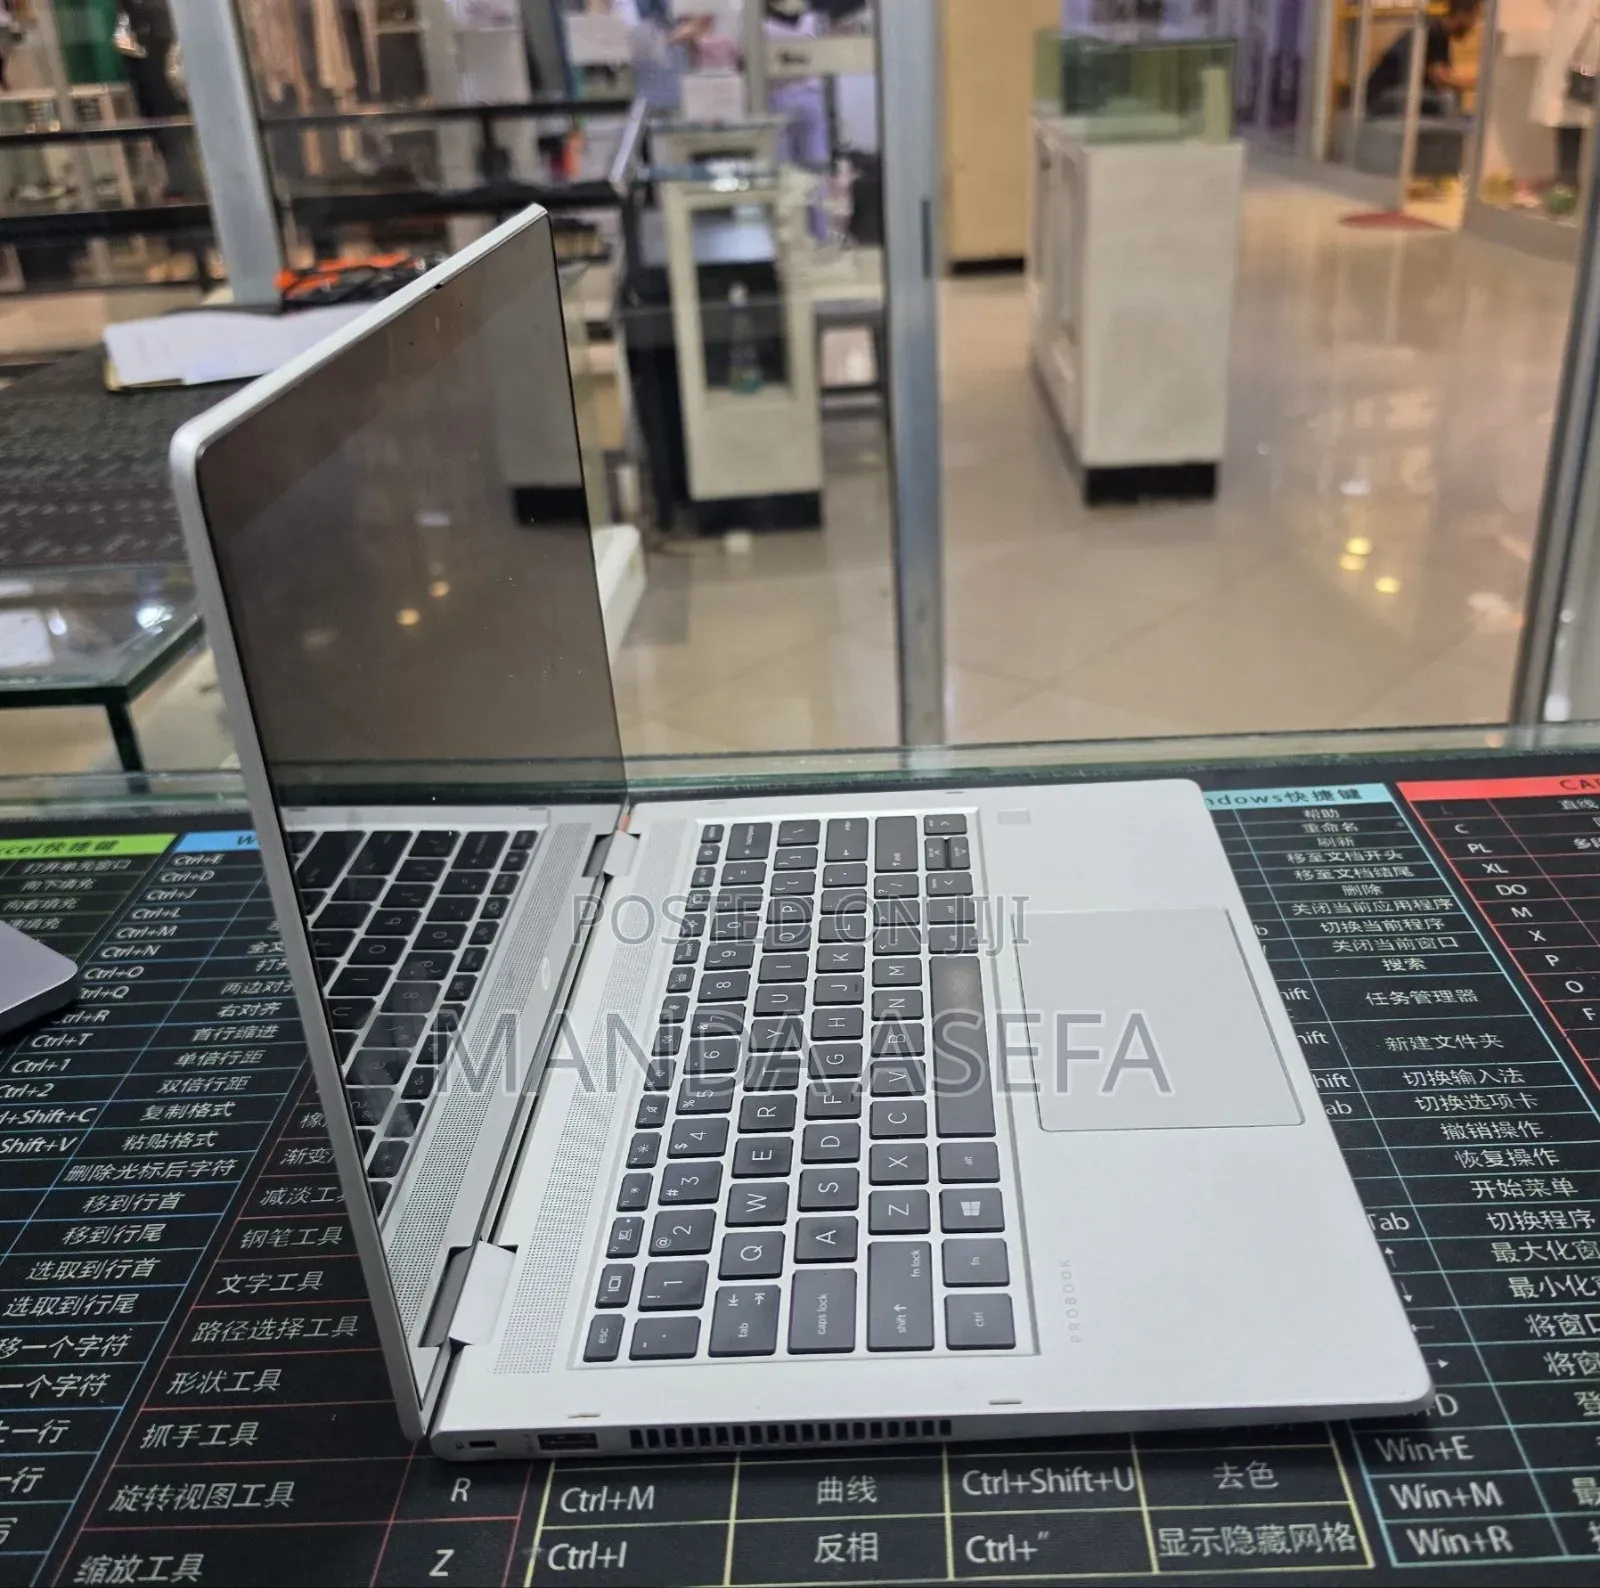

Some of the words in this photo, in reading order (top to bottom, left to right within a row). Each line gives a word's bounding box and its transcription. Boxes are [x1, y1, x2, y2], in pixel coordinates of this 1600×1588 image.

[1454, 823, 1469, 834] C
[1467, 842, 1493, 853] PL
[1482, 862, 1509, 874] XL
[160, 870, 215, 884] Ctrl+D
[146, 888, 198, 901] Ctrl+J
[1496, 884, 1527, 896] DO
[131, 907, 182, 920] Ctrl+L
[1292, 898, 1454, 916] 关闭当前应用程序
[1511, 906, 1533, 918] M
[115, 925, 178, 939] Ctrl+M
[1320, 918, 1445, 934] 切换当前程序
[1332, 936, 1459, 953] 关闭当前窗口
[1528, 930, 1546, 942] X
[101, 944, 161, 959] Ctrl+N
[832, 952, 849, 962] K
[1381, 957, 1427, 972] 搜索
[1545, 954, 1559, 967] P
[84, 965, 145, 980] Ctrl+O
[888, 965, 905, 976] M
[715, 981, 732, 989] 8
[830, 984, 848, 992] J
[770, 993, 789, 1003] U
[888, 998, 906, 1008] N
[1365, 988, 1479, 1007] 任务管理器
[1582, 1007, 1596, 1020] F
[828, 1017, 846, 1028] H
[31, 1033, 94, 1048] Ctrl+T
[766, 1028, 785, 1039] Y
[888, 1033, 906, 1044] B
[1384, 1033, 1505, 1052] 新建文件夹
[174, 1050, 266, 1067] 单倍行距
[703, 1050, 720, 1059] 6
[826, 1053, 845, 1065] G
[11, 1058, 72, 1074] Ctrl+1
[157, 1076, 252, 1094] 双倍行距
[888, 1071, 907, 1083] V
[1402, 1068, 1526, 1087] 切换输入法
[823, 1094, 842, 1104] F
[1415, 1092, 1539, 1113] 切换选项卡
[140, 1101, 237, 1121] 复制格式
[756, 1106, 777, 1117] R
[887, 1112, 908, 1124] C
[689, 1130, 708, 1141] 4
[1440, 1121, 1544, 1141] 撤销操作
[121, 1130, 219, 1150] 粘贴格式
[820, 1135, 840, 1148] D
[751, 1149, 773, 1161] E
[888, 1155, 908, 1168] X
[1454, 1147, 1561, 1169] 恢复操作
[64, 1158, 239, 1183] 删除光标后字符
[680, 1176, 699, 1186] 3
[818, 1181, 839, 1193] S
[1470, 1177, 1579, 1200] 开始菜单
[82, 1192, 186, 1213] 移到行首
[260, 1186, 346, 1206] 减淡工
[745, 1193, 768, 1213] W
[888, 1203, 910, 1216] Z
[1486, 1209, 1596, 1232] 切换程序
[62, 1223, 167, 1246] 移到行尾
[241, 1226, 344, 1250] 钢笔工具
[672, 1225, 692, 1236] 2
[815, 1229, 837, 1245] A
[740, 1244, 763, 1262] Q
[912, 1249, 921, 1266] lock
[26, 1258, 161, 1282] 选取到行首
[217, 1270, 324, 1295] 文字工具
[3, 1292, 140, 1318] 选取到行尾
[818, 1293, 828, 1311] lock
[1060, 1259, 1083, 1343] PROBOOK
[817, 1313, 828, 1335] caps
[899, 1312, 907, 1334] shift
[973, 1311, 984, 1327] ctrl
[191, 1315, 359, 1344] 路径选择工具
[598, 1327, 609, 1344] esc
[737, 1322, 749, 1338] tab
[166, 1368, 283, 1396] 形状工具
[140, 1421, 260, 1450] 抓手工具
[1374, 1435, 1476, 1462] Win+E
[962, 1466, 1136, 1497] Ctrl+Shift+U
[1213, 1461, 1280, 1491] 去色
[108, 1481, 296, 1513] 旋转视图工具
[450, 1477, 472, 1503] R
[816, 1475, 878, 1504] 曲线
[1389, 1480, 1505, 1511] Win+M
[560, 1485, 656, 1514] Ctrl+M
[814, 1532, 880, 1564] 反相
[1158, 1521, 1358, 1558] 显示隐藏网格
[1406, 1525, 1515, 1556] Win+R
[73, 1553, 206, 1586] 缩放工具
[429, 1549, 455, 1577] Z
